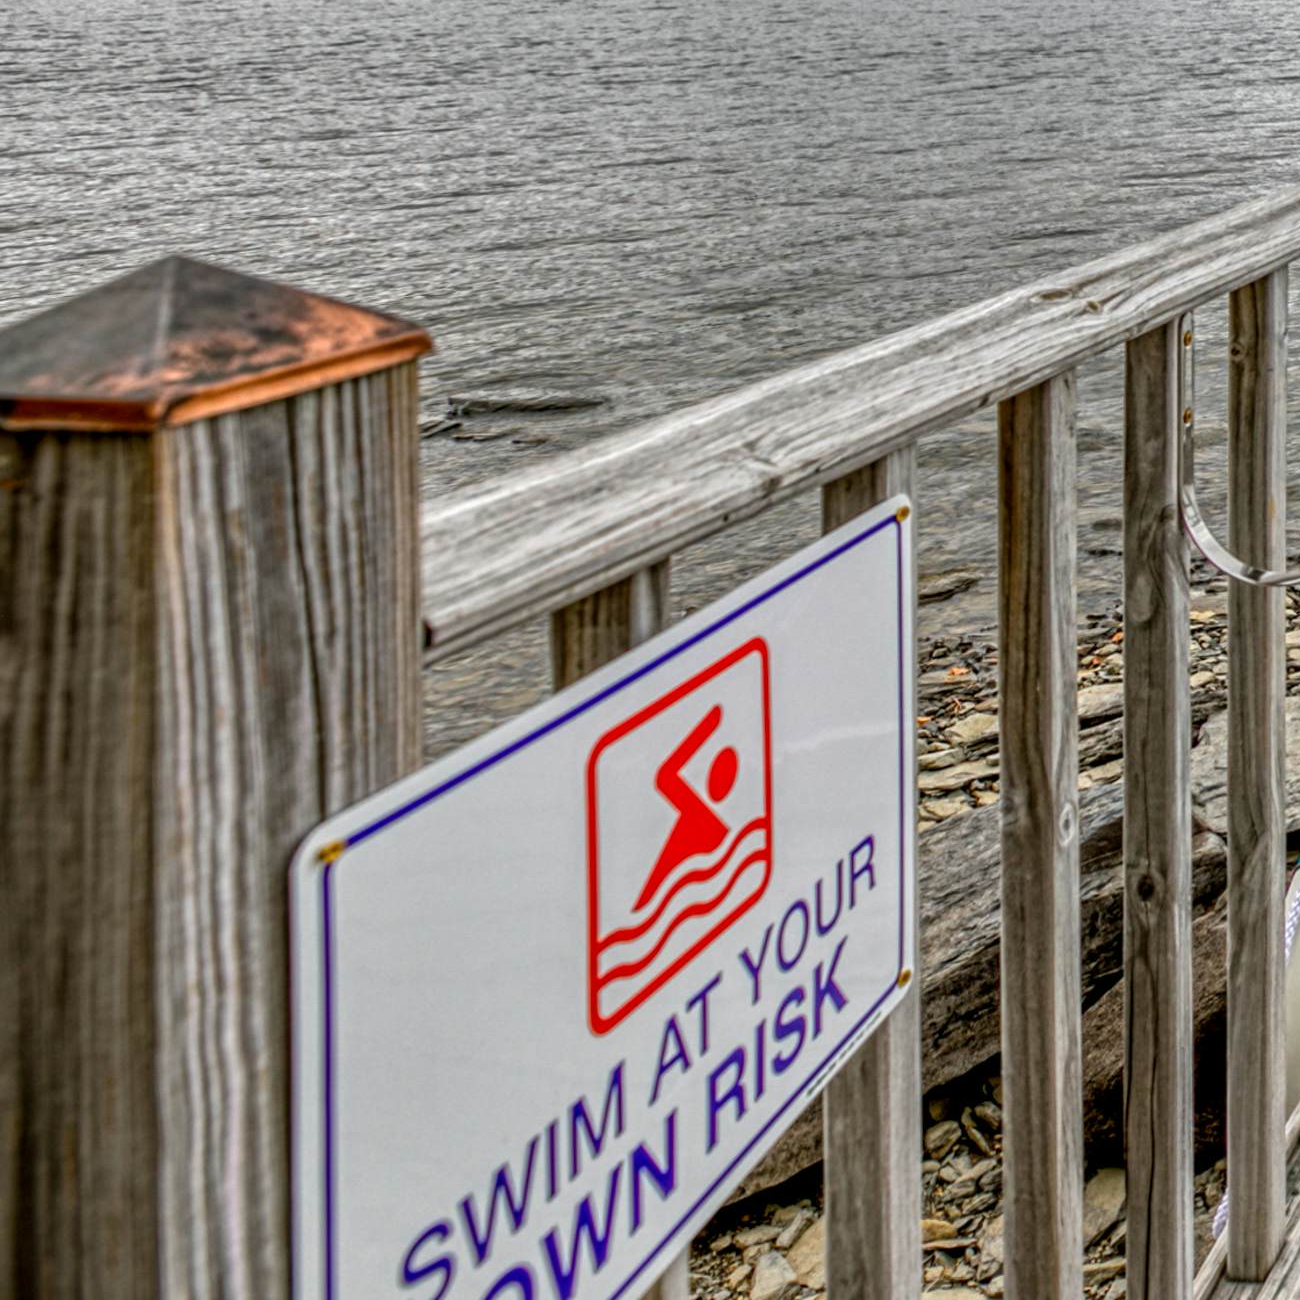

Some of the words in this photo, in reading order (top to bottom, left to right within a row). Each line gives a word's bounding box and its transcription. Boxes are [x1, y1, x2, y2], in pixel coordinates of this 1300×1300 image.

[398, 1060, 625, 1300] SWIM
[649, 971, 722, 1107] AT
[739, 835, 876, 1006] YOUR
[706, 935, 849, 1154] RISK
